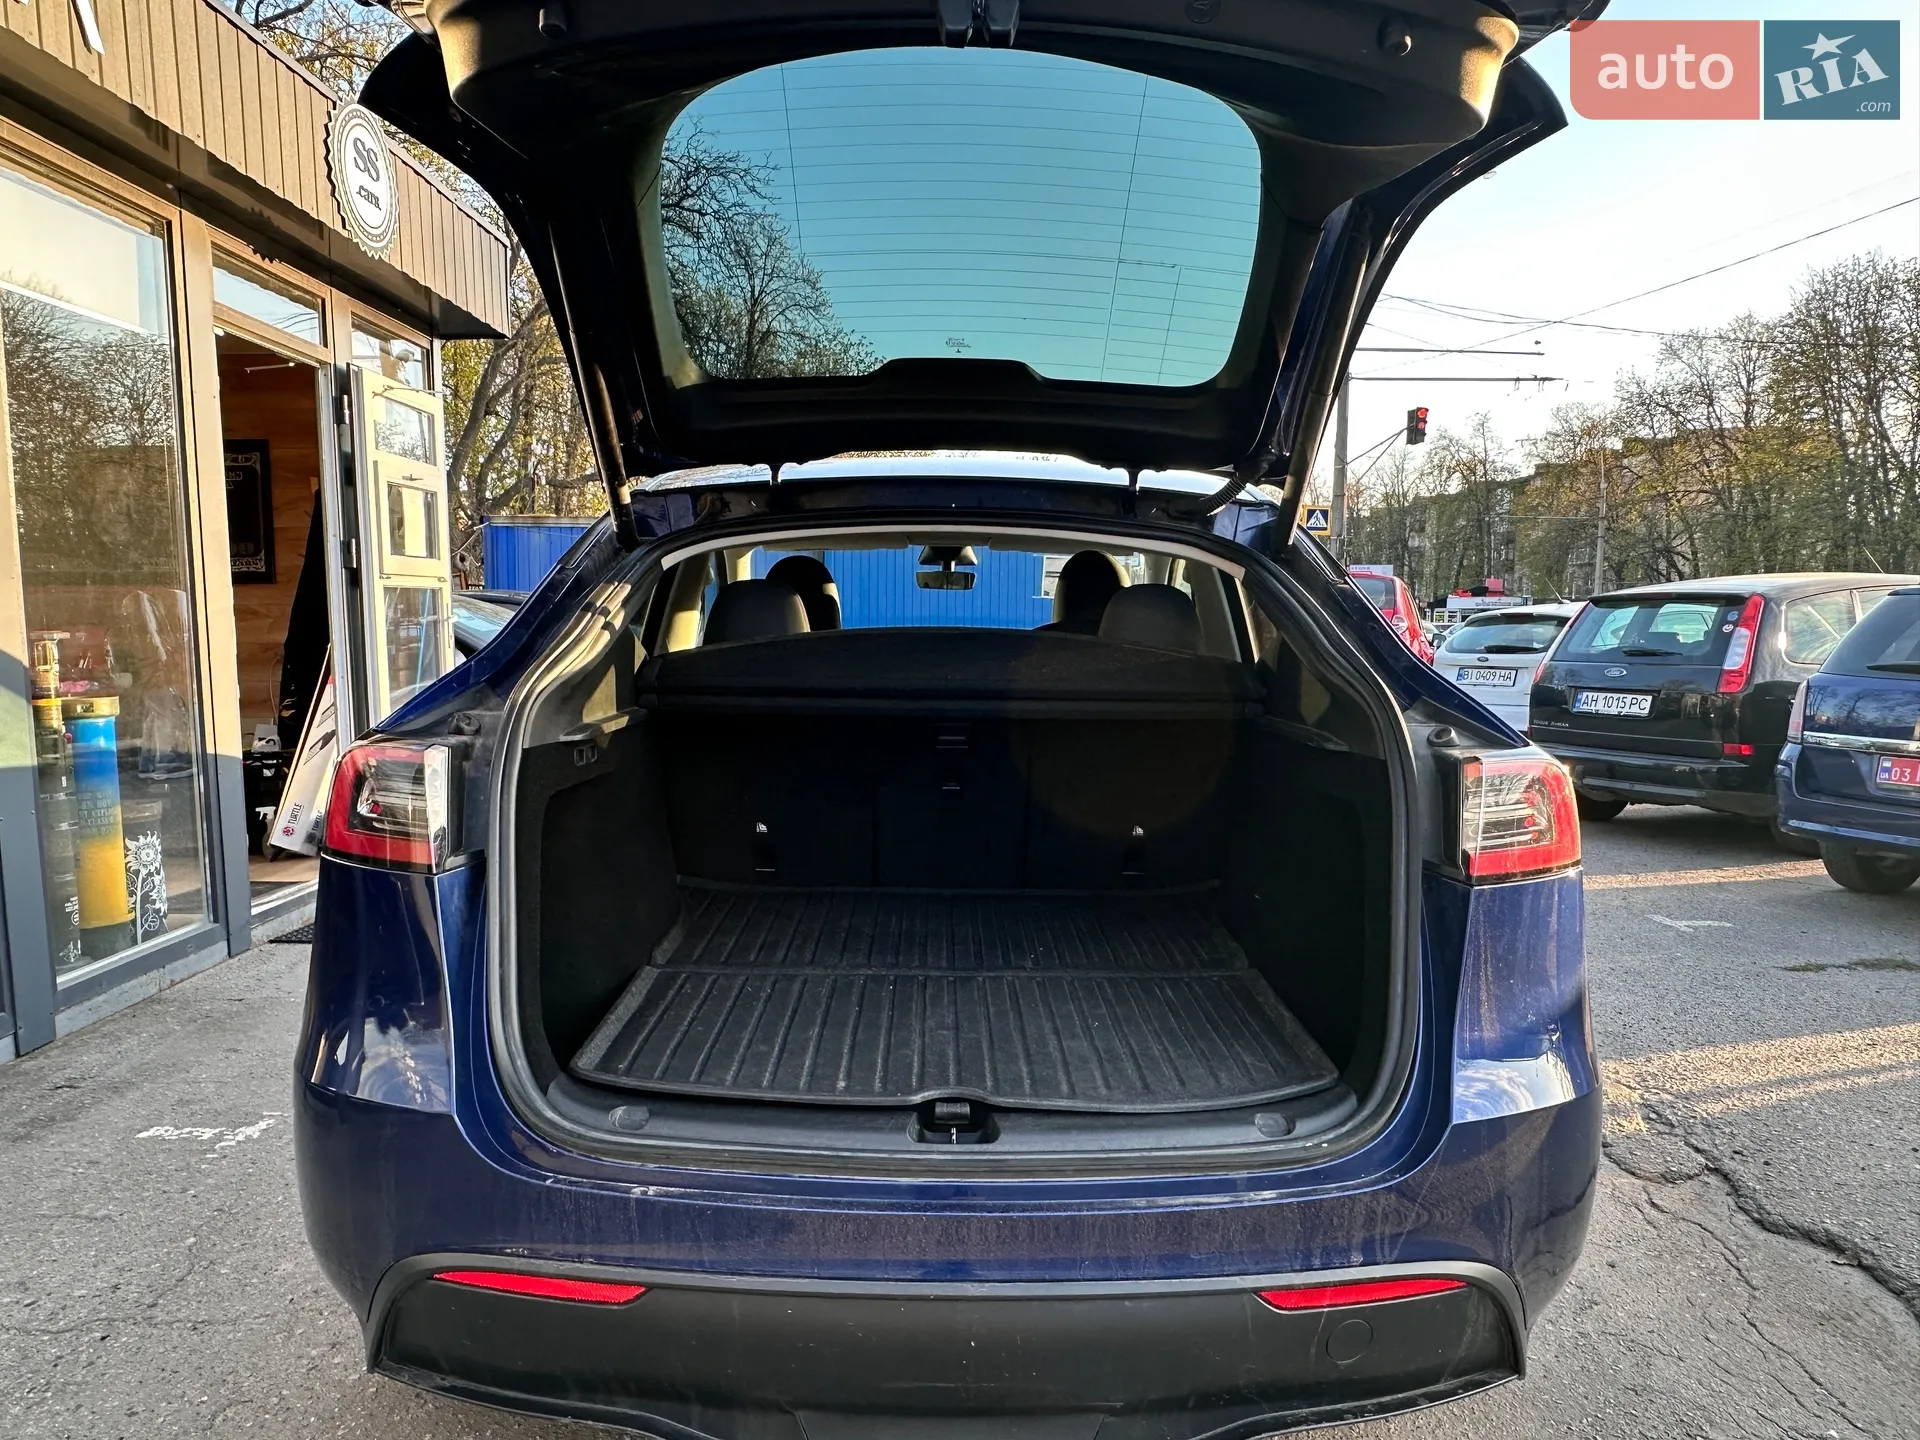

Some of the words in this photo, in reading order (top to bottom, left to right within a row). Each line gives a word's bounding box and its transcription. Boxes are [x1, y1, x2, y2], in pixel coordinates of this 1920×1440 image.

[353, 137, 380, 183] SS
[1476, 671, 1497, 681] 0409
[1498, 671, 1512, 682] HA
[1581, 694, 1599, 708] AH
[1602, 695, 1628, 709] 1015
[1629, 697, 1648, 711] PC
[1891, 767, 1911, 782] 03
[287, 801, 303, 825] TURTLE
